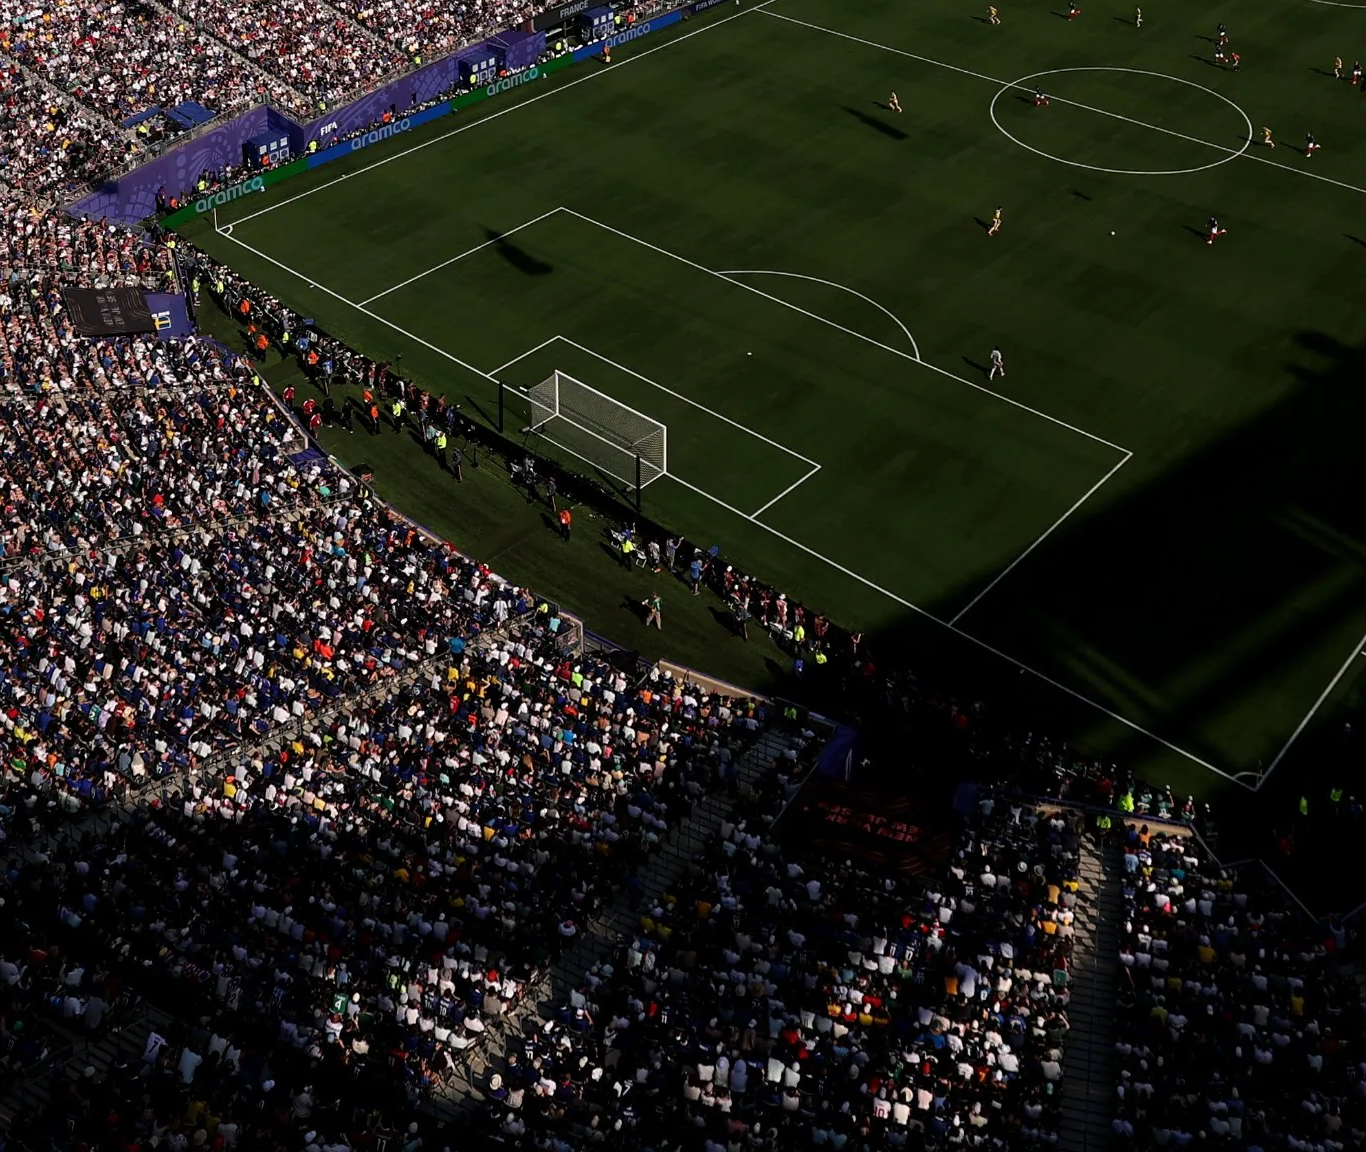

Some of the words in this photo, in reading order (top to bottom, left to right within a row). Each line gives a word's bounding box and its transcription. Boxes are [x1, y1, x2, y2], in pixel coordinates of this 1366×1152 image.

[560, 0, 589, 19] FRANCE
[696, 2, 708, 11] FIFA
[605, 23, 651, 48] aramco
[486, 67, 539, 97] aramco
[320, 122, 338, 136] FIFA
[351, 118, 411, 150] aramco
[195, 176, 263, 213] aramco
[148, 1040, 159, 1054] 7
